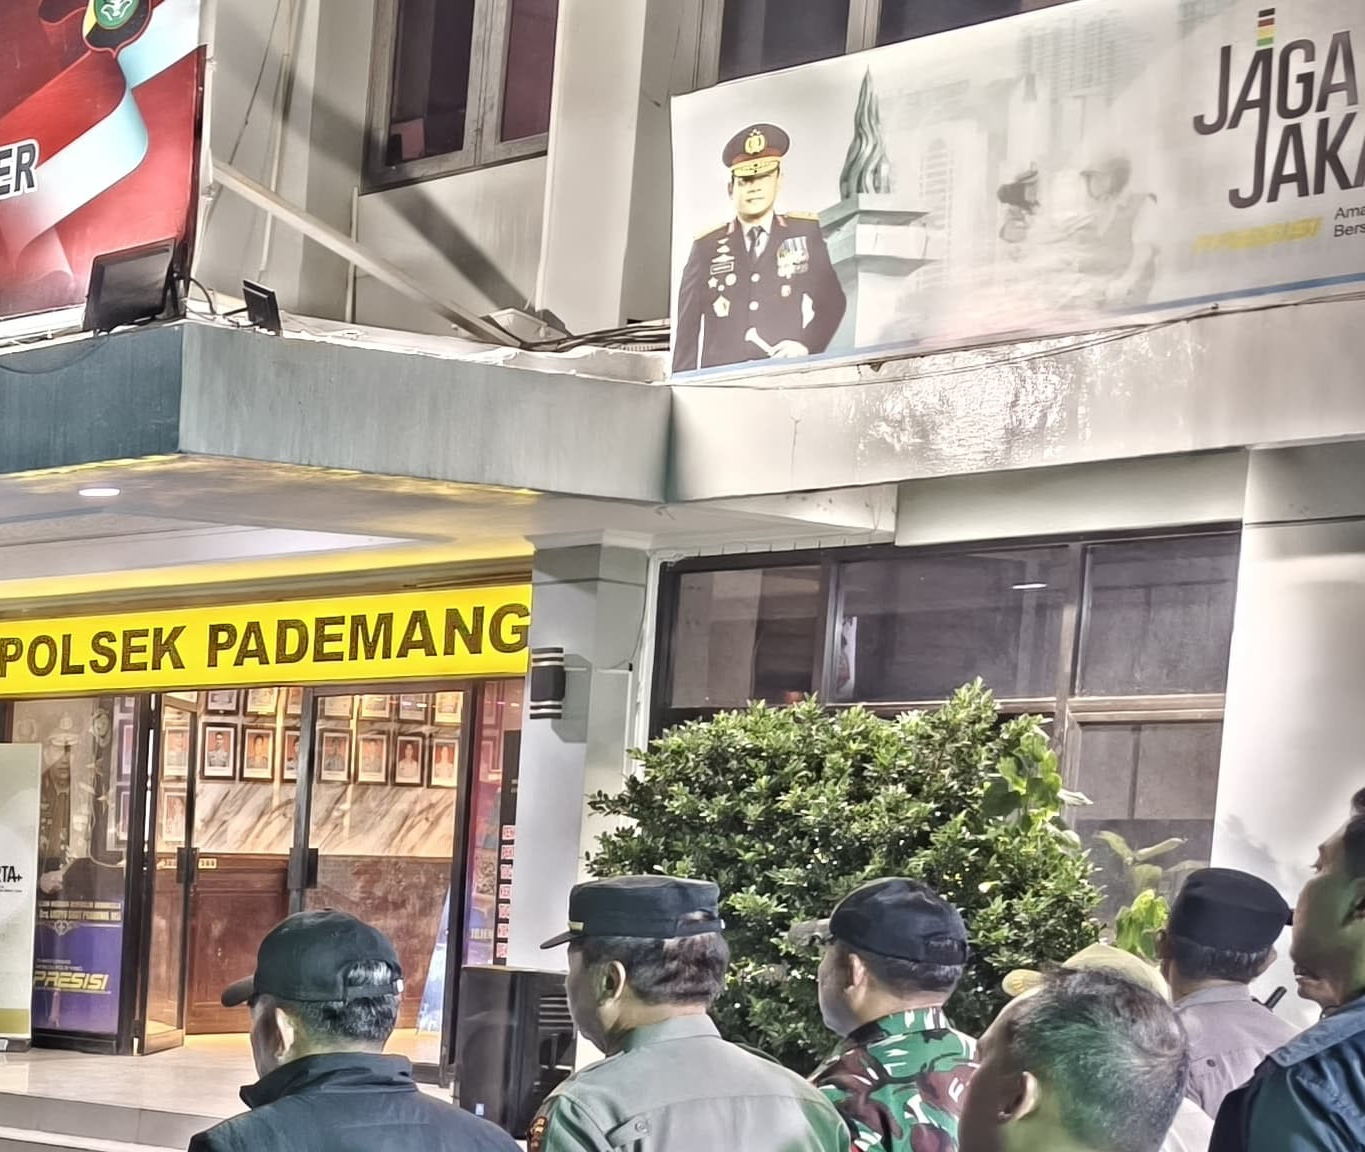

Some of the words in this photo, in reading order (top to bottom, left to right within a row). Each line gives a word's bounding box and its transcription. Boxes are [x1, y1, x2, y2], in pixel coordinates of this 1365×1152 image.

[1193, 30, 1359, 135] JAGA
[206, 602, 531, 668] PADEMANG
[33, 971, 109, 990] PRESISI
